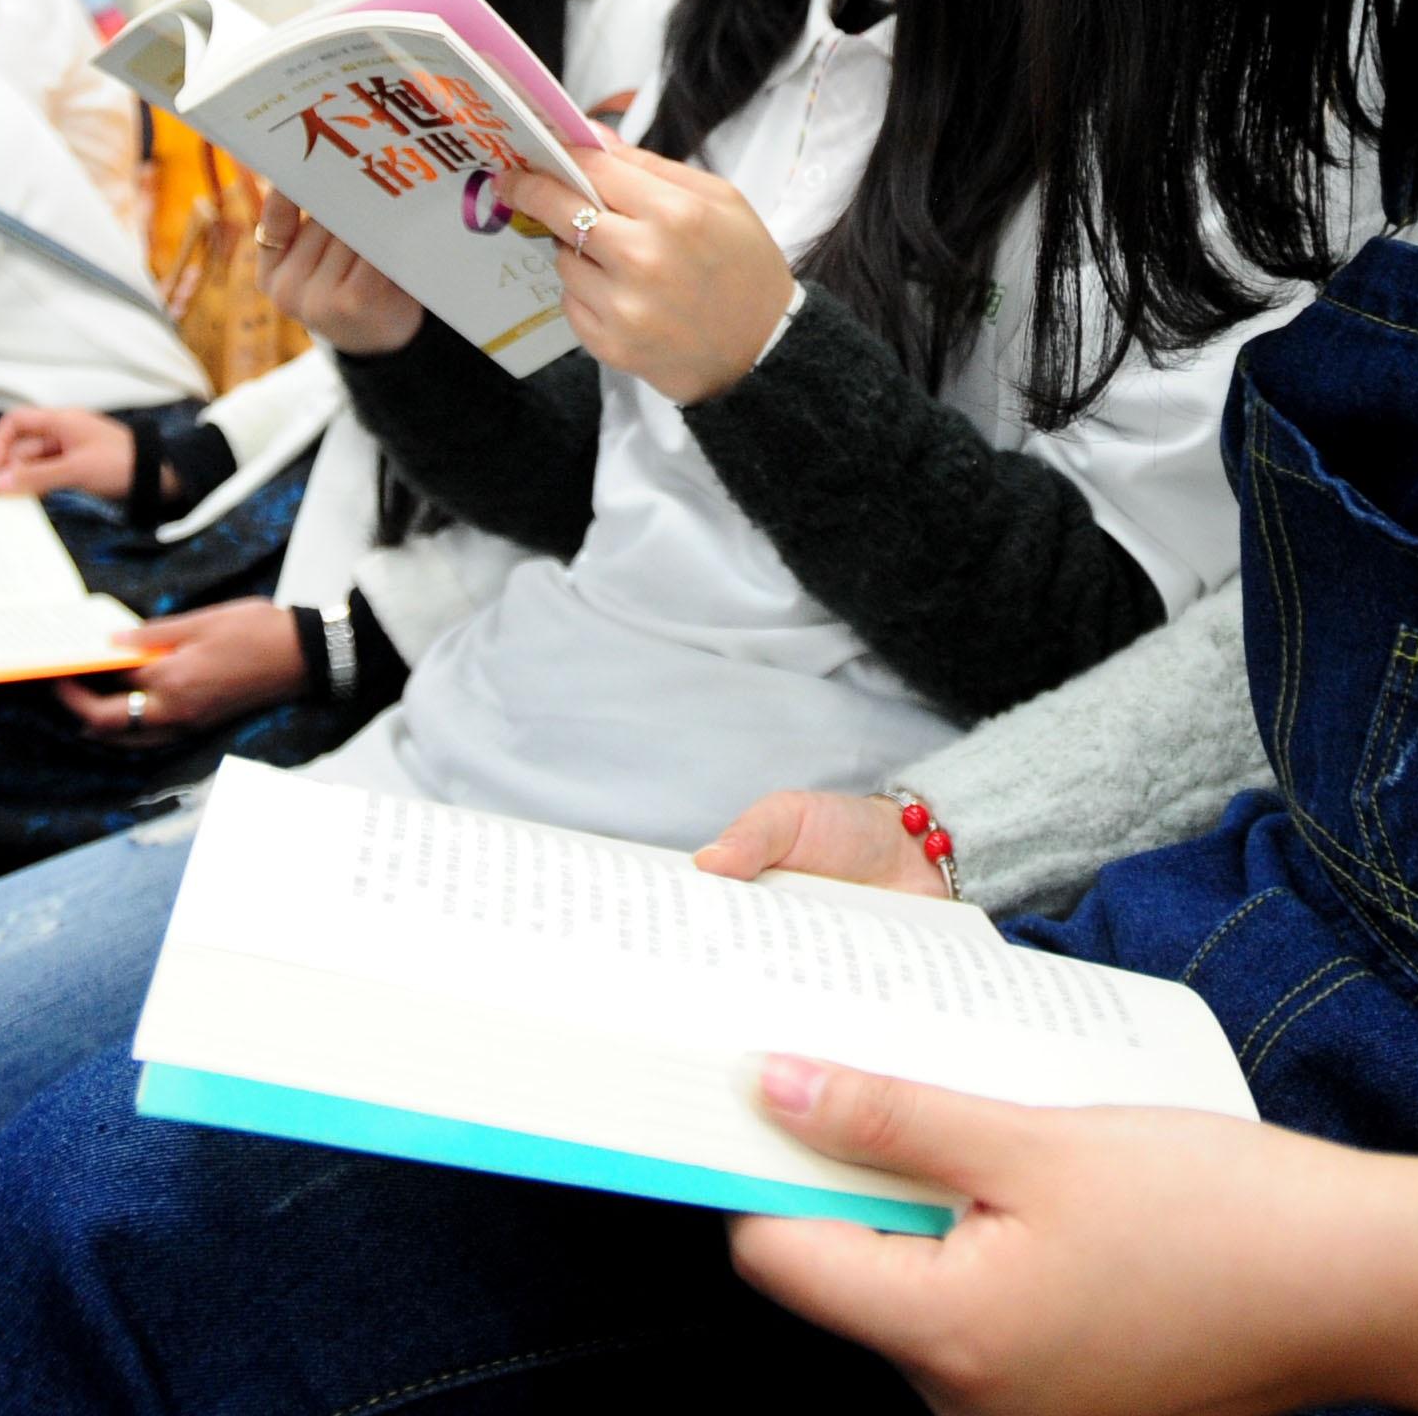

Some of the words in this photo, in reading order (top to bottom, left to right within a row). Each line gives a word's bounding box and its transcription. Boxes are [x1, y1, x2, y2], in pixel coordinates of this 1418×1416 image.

[268, 71, 513, 162] 不抱怨
[360, 130, 531, 198] 的世界
